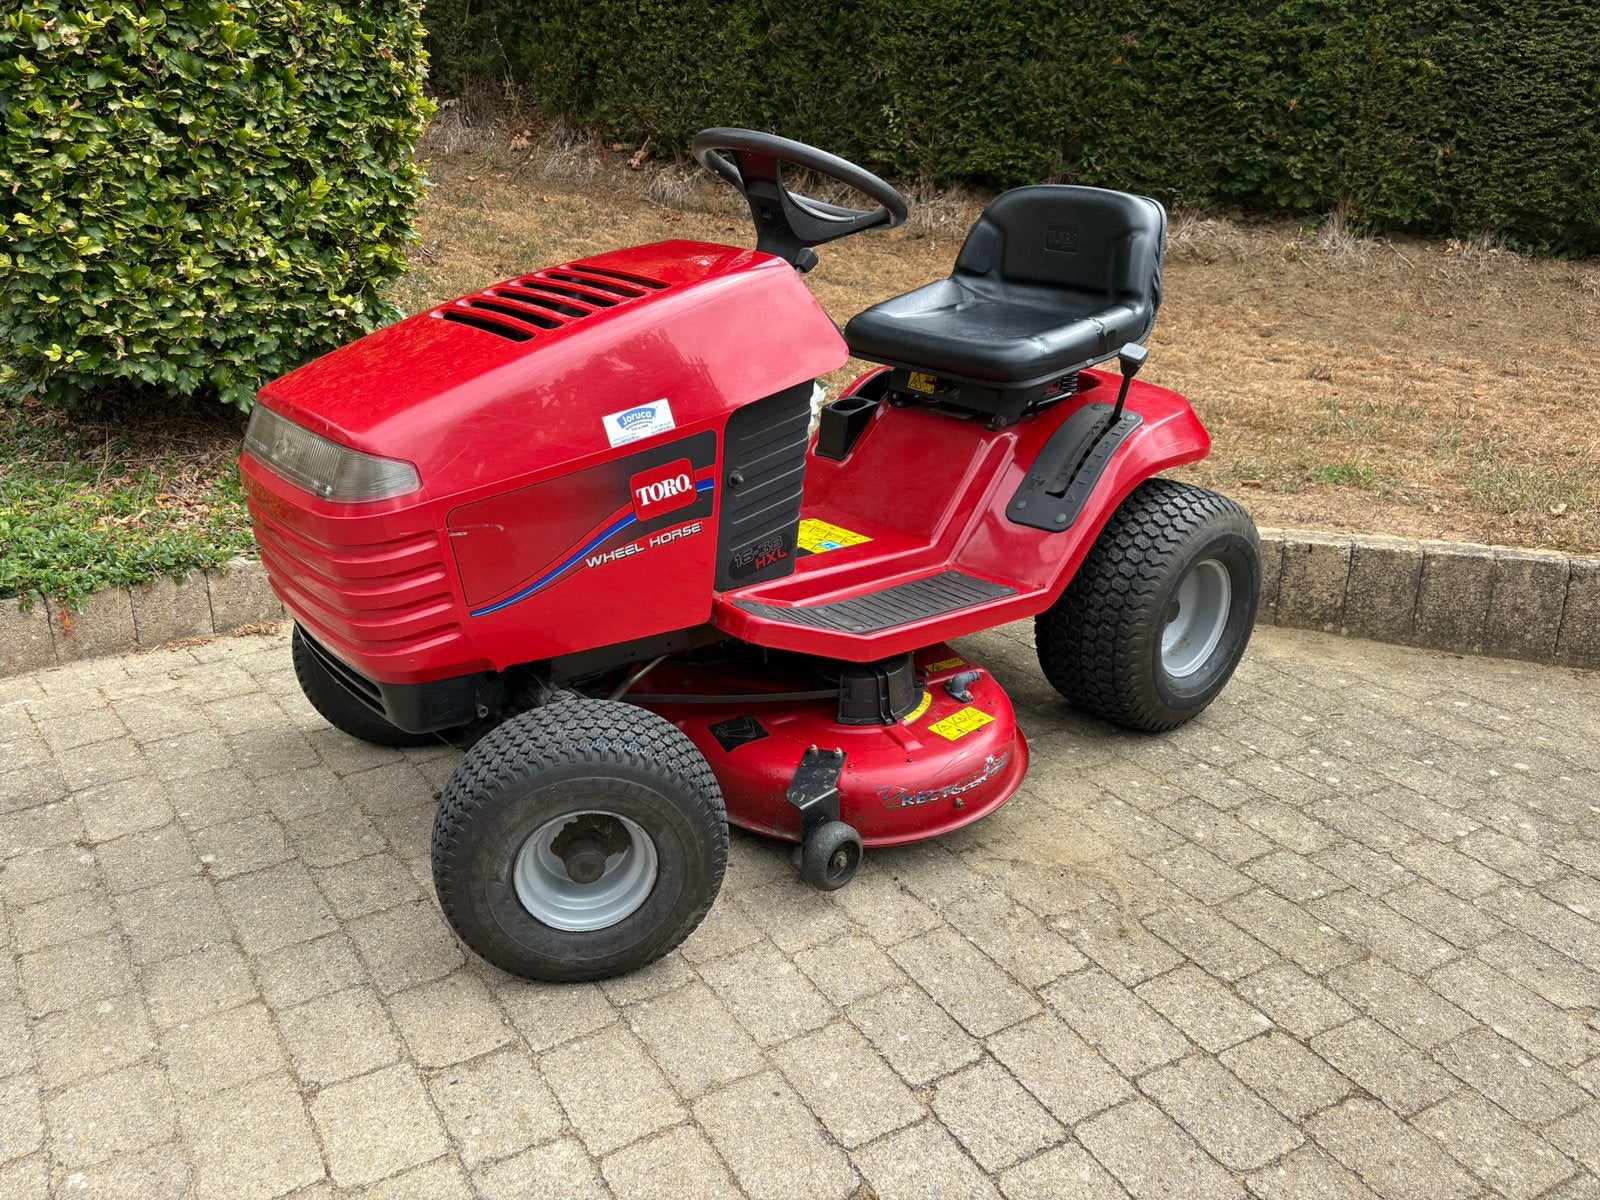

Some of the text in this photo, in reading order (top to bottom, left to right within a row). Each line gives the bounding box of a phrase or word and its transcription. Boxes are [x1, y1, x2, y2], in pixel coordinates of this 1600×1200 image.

[622, 410, 652, 426] Joruca
[585, 522, 703, 568] WHEEL HORSE
[755, 548, 788, 570] HXL
